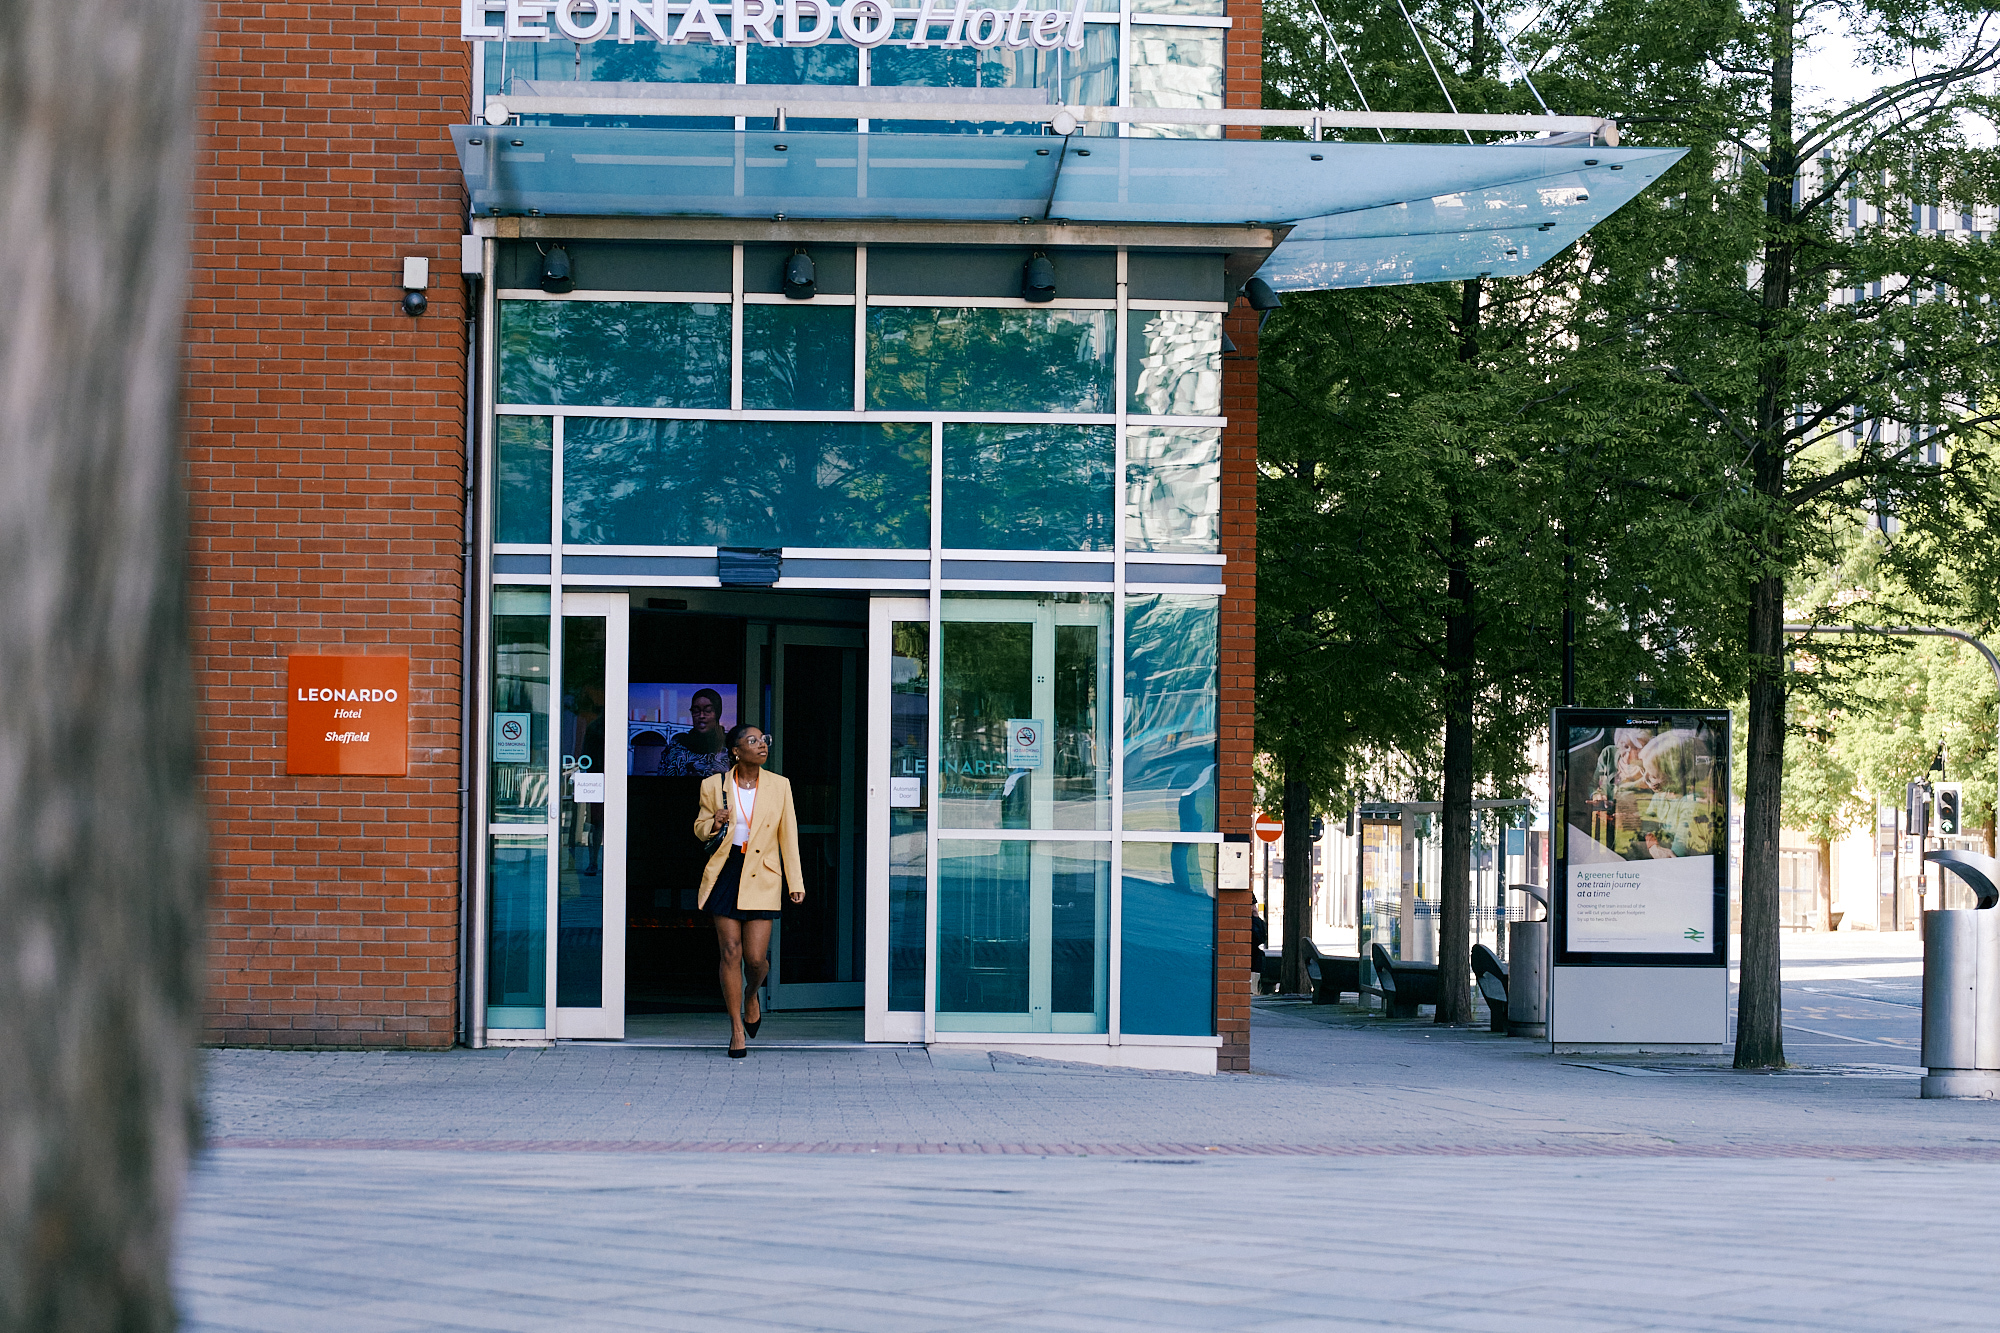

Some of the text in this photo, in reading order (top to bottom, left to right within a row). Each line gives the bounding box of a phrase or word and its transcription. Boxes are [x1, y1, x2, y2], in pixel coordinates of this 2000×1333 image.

[461, 0, 1085, 50] LEONARDO Hotel
[298, 688, 398, 702] LEONARDO
[334, 709, 362, 718] Hotel
[325, 732, 370, 744] Sheffield
[946, 784, 978, 794] Hotel
[1584, 872, 1614, 880] greener
[1611, 881, 1641, 890] journey
